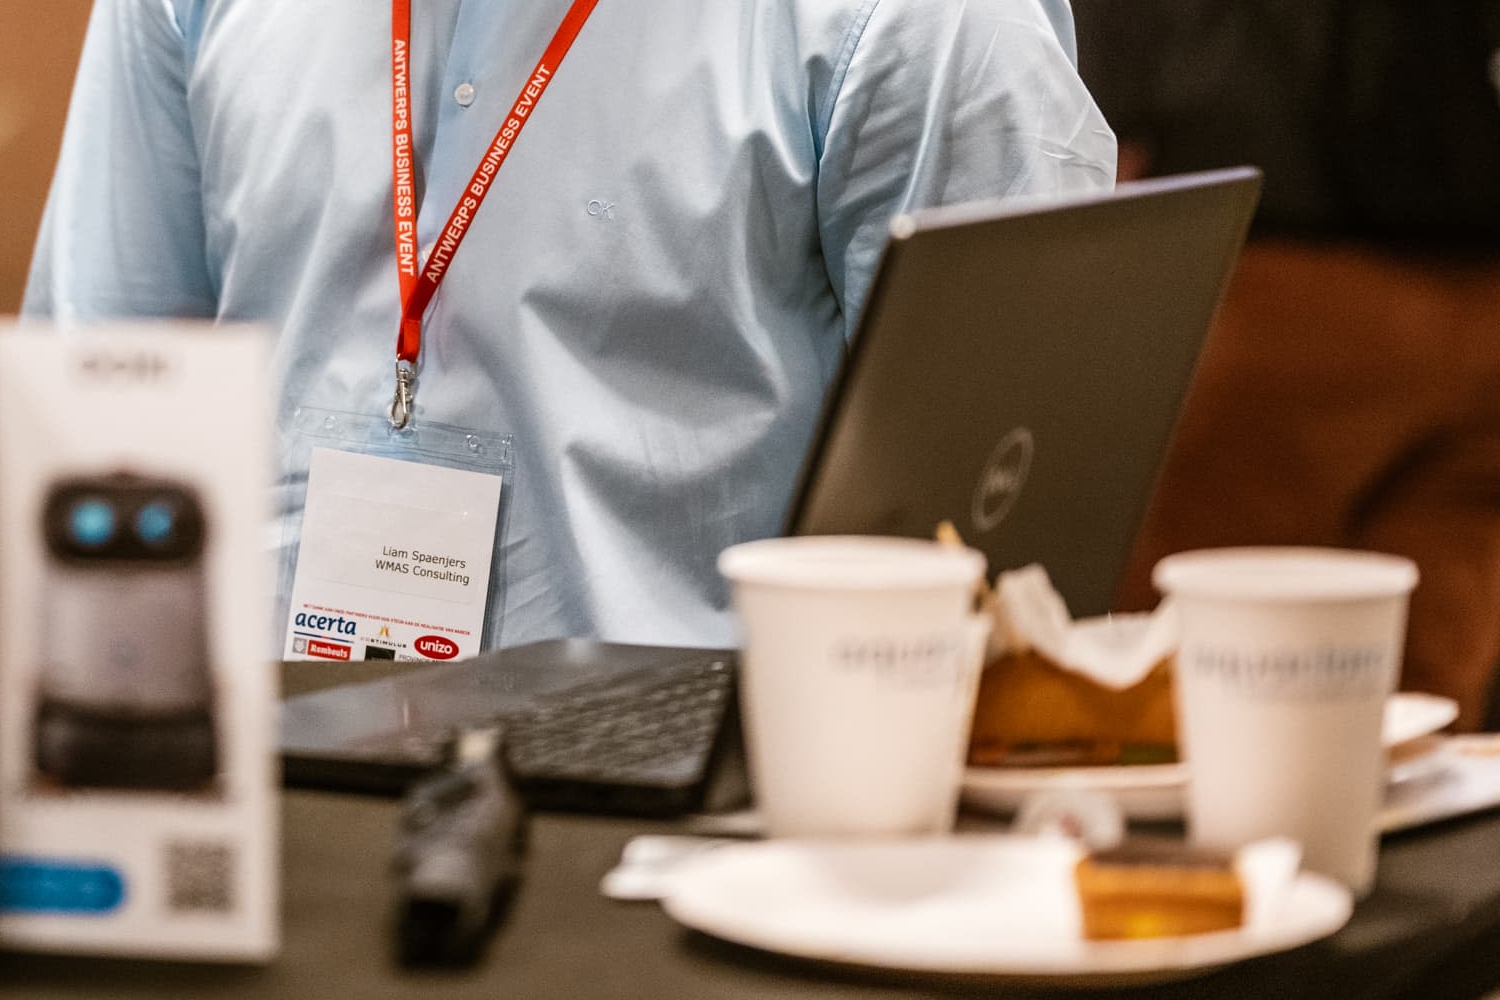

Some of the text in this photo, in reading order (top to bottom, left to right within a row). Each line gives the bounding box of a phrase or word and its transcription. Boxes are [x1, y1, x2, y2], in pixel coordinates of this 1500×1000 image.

[394, 39, 415, 276] ANTWERPS BUSINESS EVENT
[426, 63, 551, 284] ANTWERPS BUSINESS EVENT
[382, 545, 467, 569] Liam Spaenjers
[375, 559, 470, 586] WMAS Consulting
[295, 612, 357, 636] acerta
[419, 640, 453, 655] unizo
